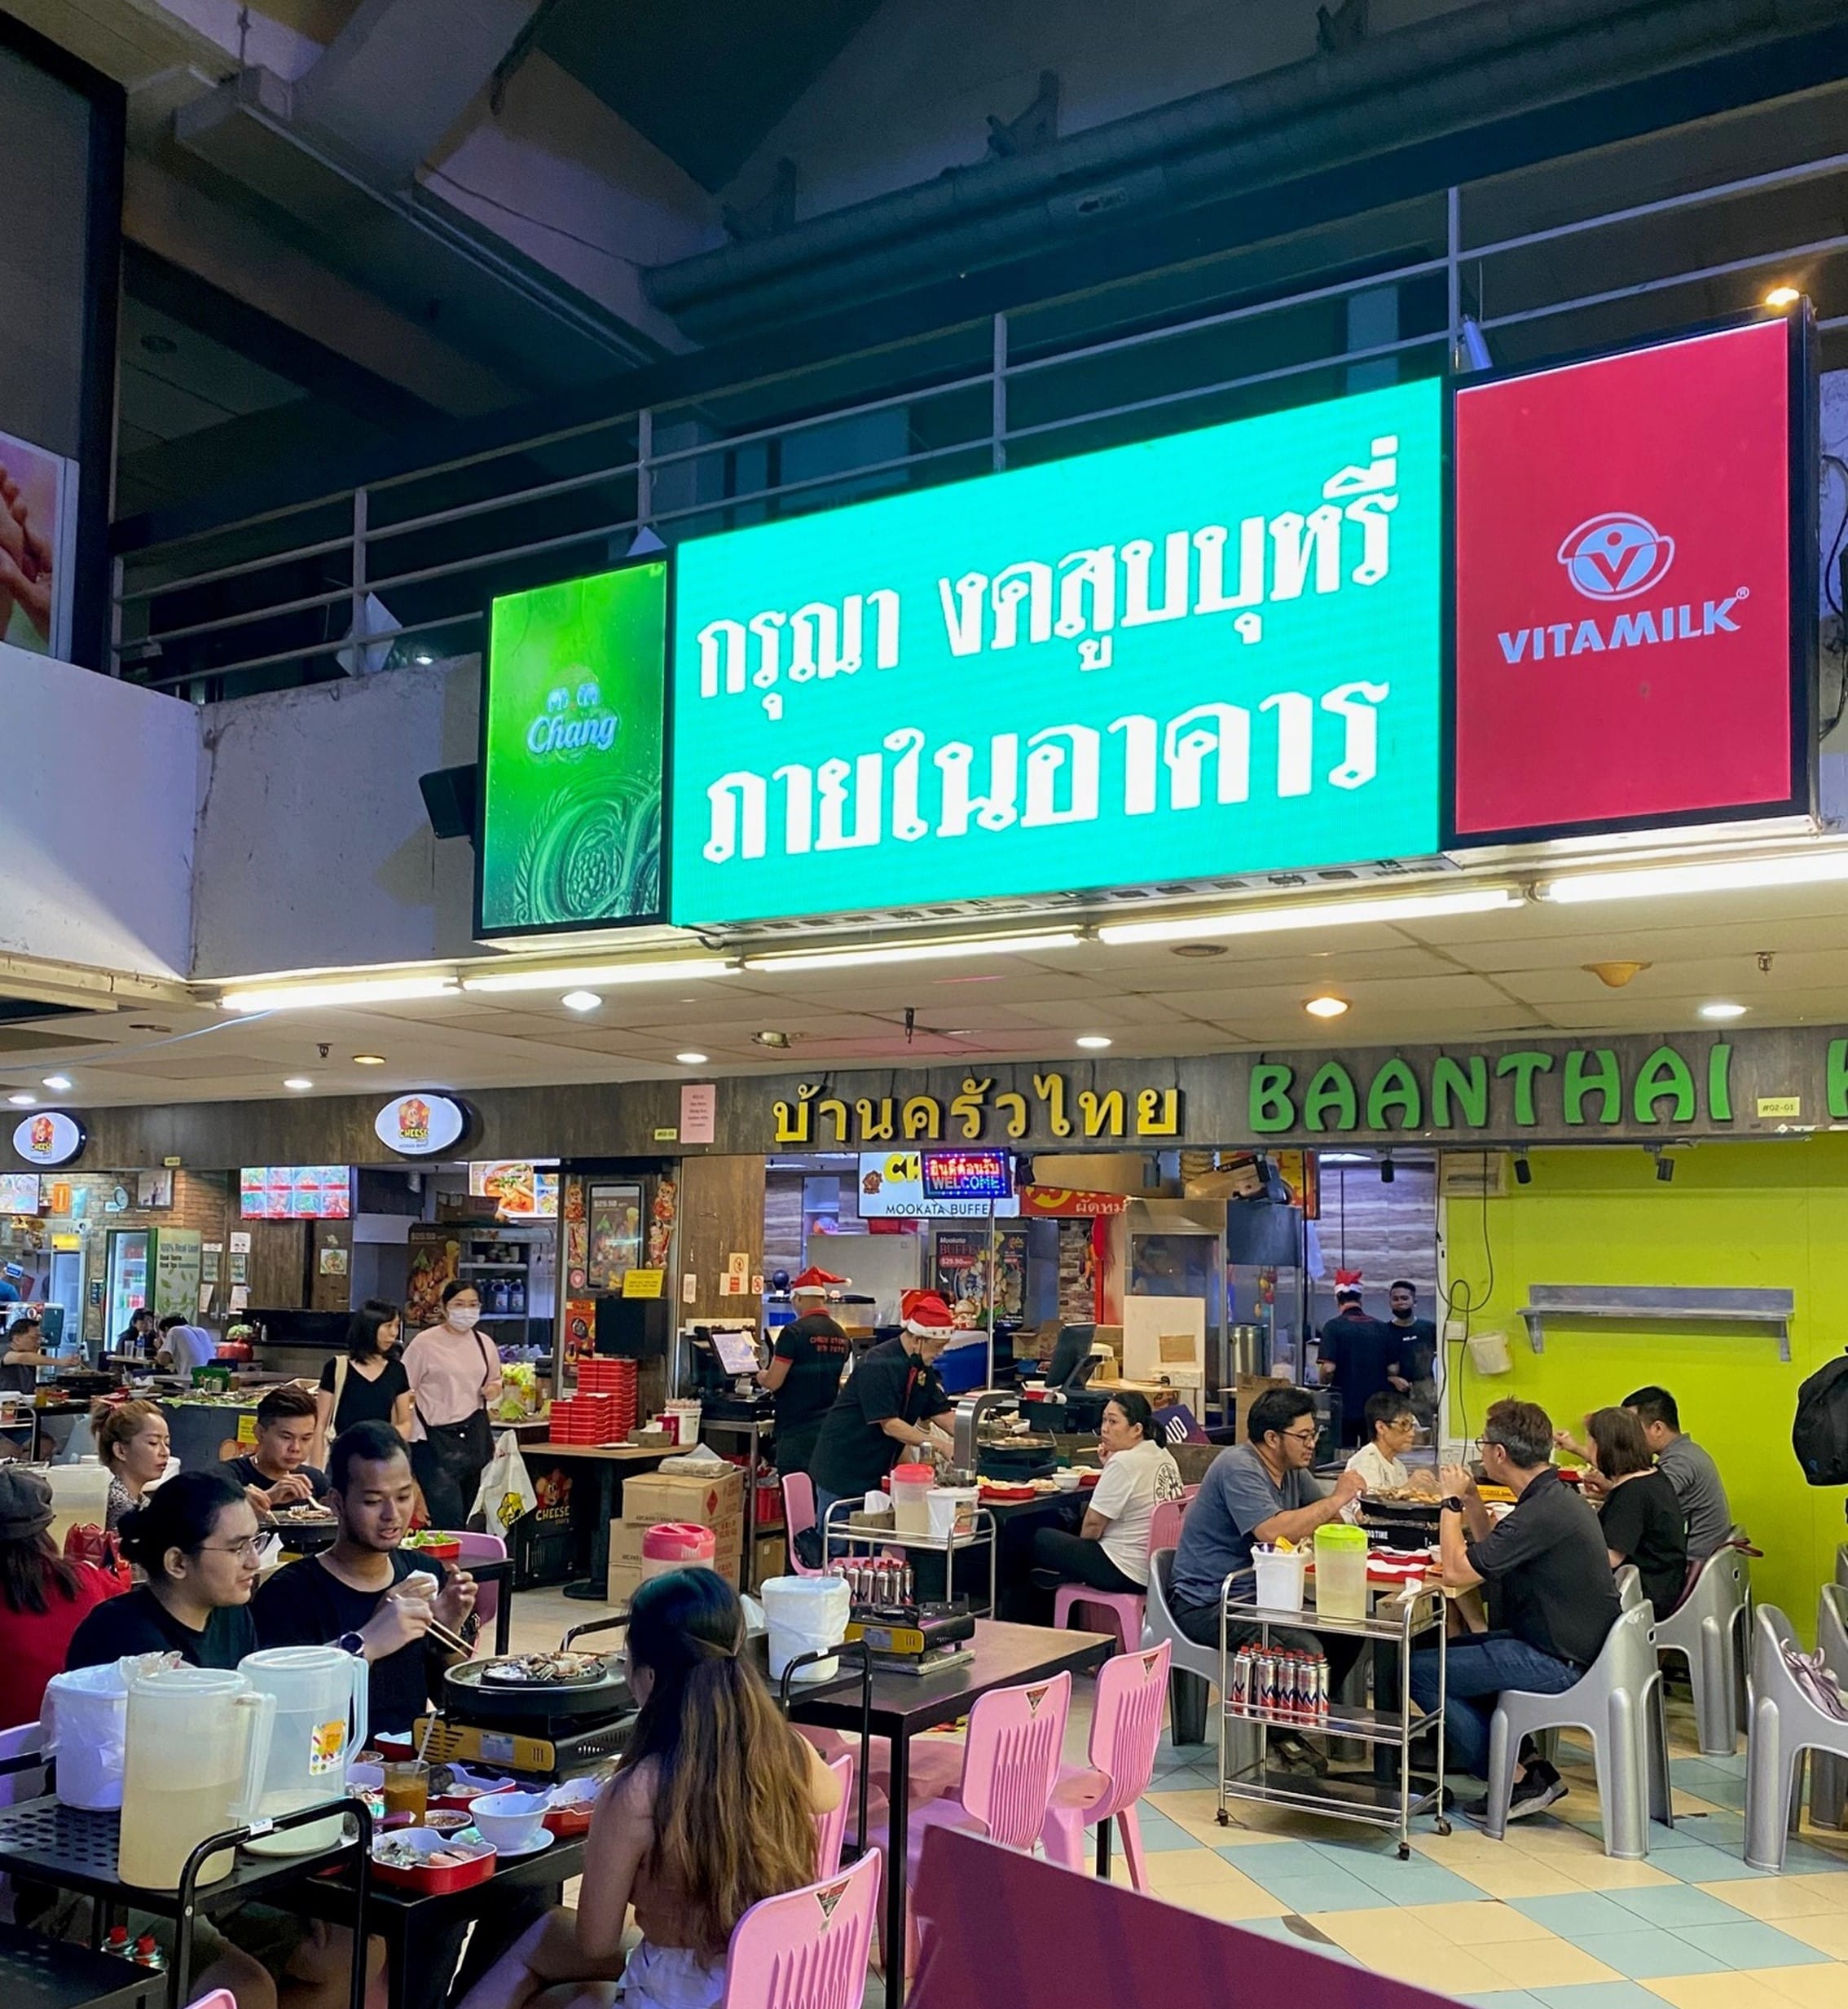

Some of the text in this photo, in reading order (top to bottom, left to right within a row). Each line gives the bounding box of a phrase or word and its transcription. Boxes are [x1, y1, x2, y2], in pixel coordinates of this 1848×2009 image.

[697, 434, 1400, 720] กรุณา งดสูบบุหรี่
[526, 715, 618, 754] Chang
[702, 679, 1390, 865] ภายในอาคาร
[1249, 1043, 1732, 1133] BAANTHAI
[772, 1073, 1178, 1143] บ้านครัวไทย
[398, 1128, 429, 1139] CHEESE
[932, 1176, 1001, 1190] WELCOME
[886, 1204, 993, 1215] MOOKATA BUFFE
[535, 1506, 570, 1522] CHEESE
